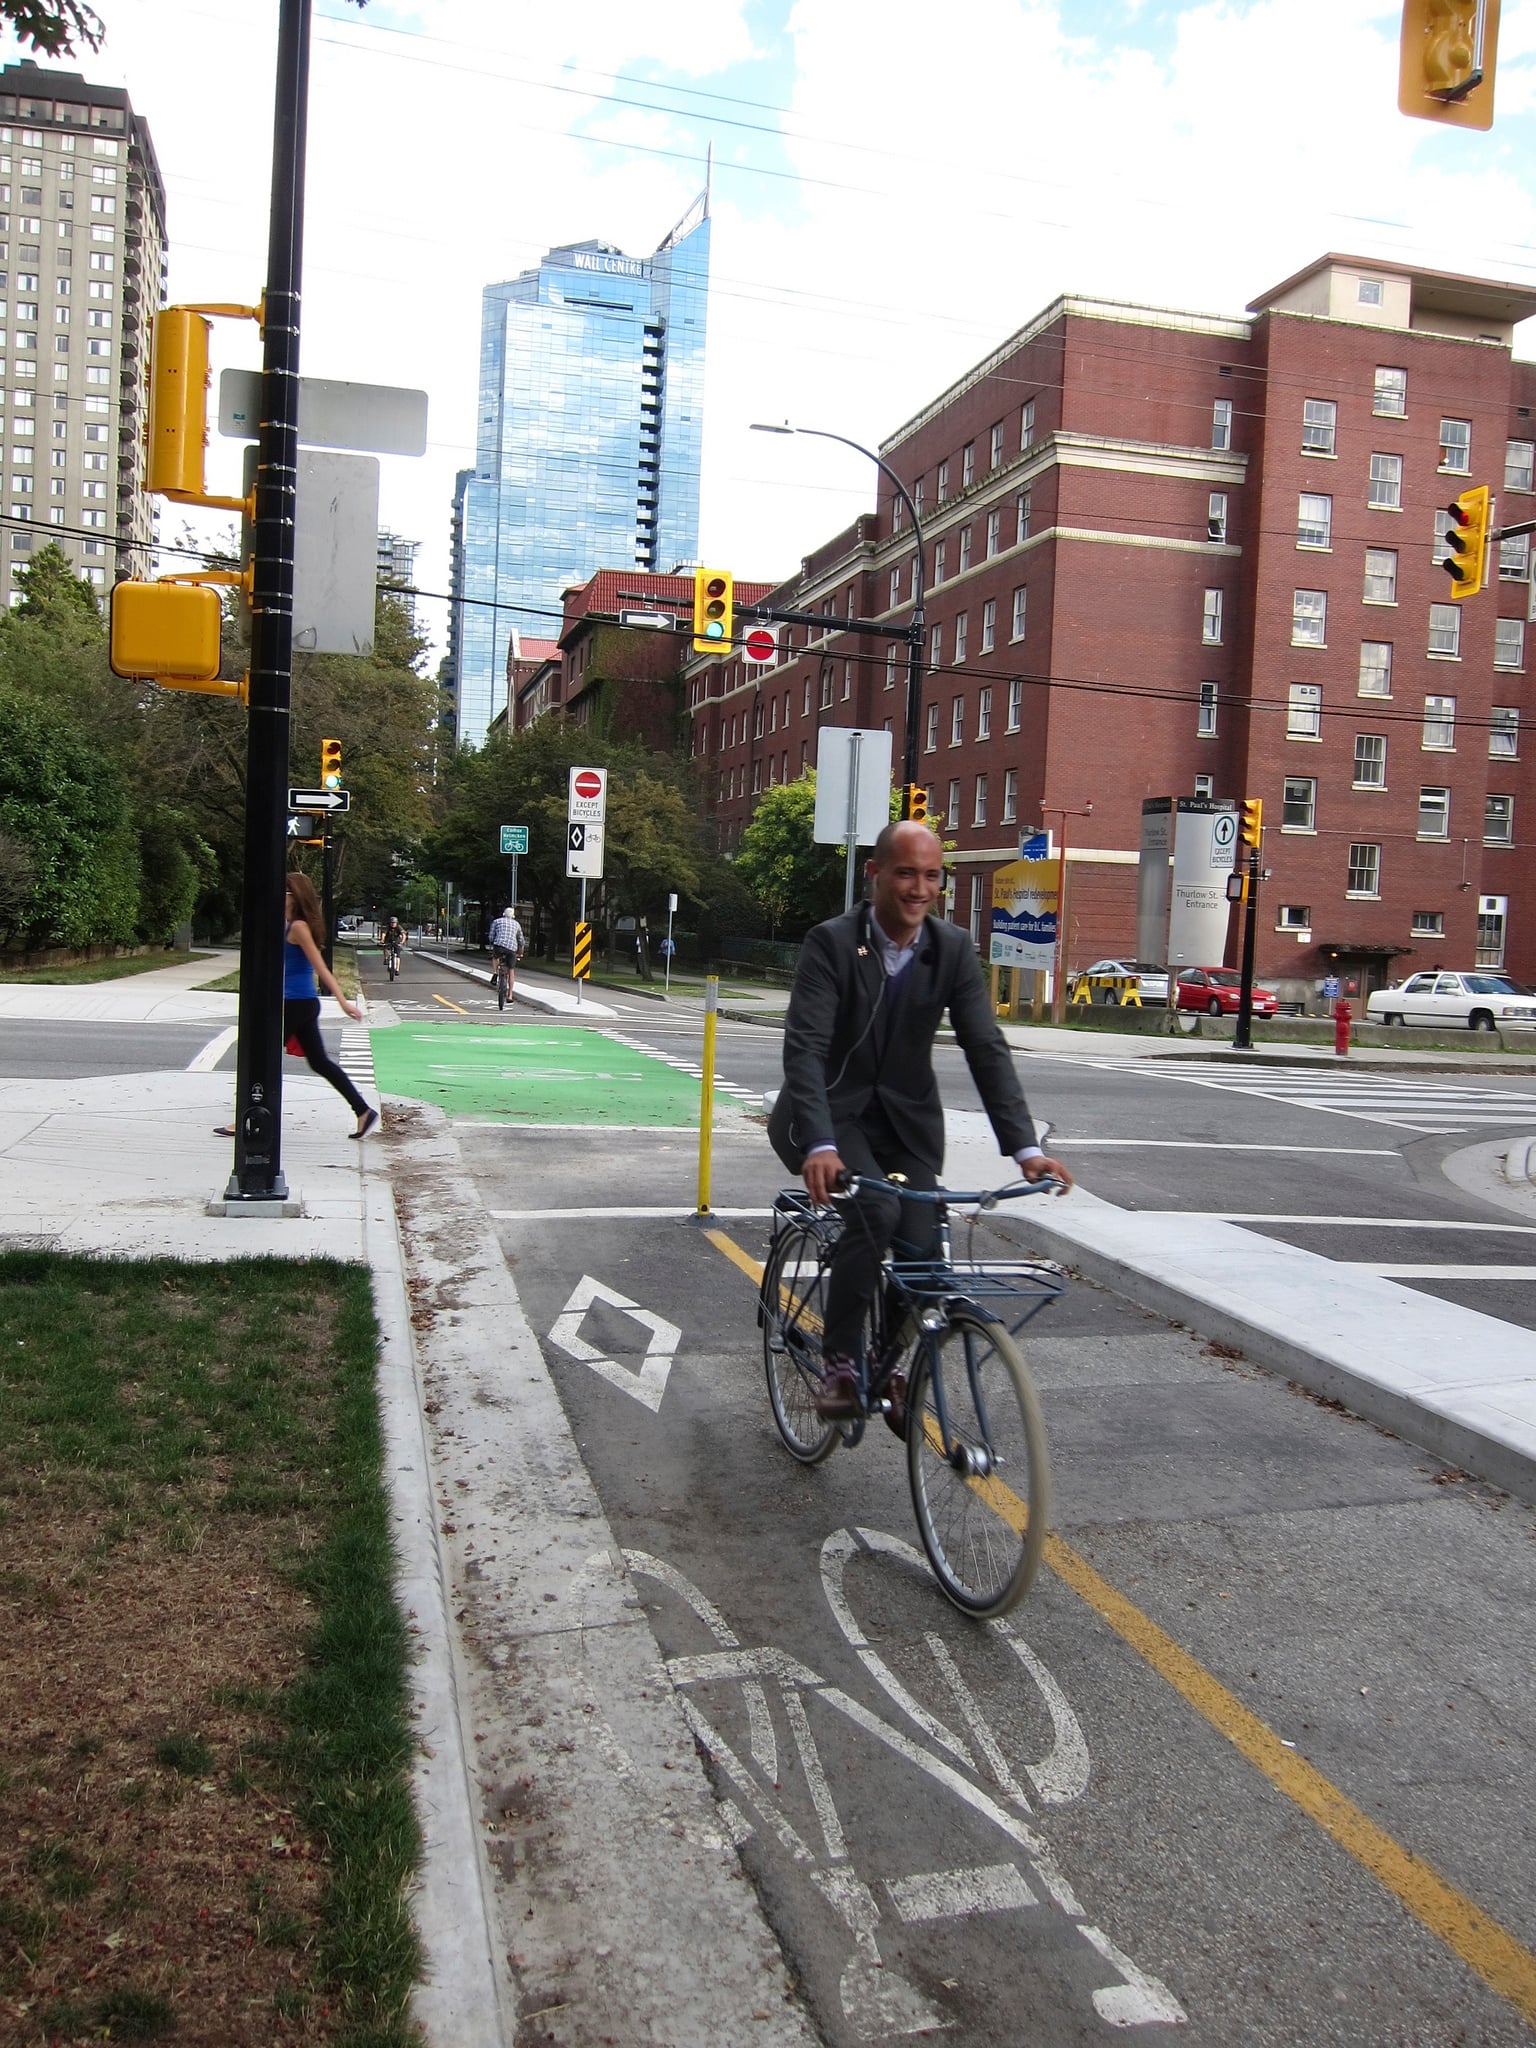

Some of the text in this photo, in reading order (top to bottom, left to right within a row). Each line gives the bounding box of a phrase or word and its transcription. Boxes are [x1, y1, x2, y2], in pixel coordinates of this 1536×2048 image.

[574, 253, 642, 277] WALL CENTRE
[575, 801, 599, 809] EXCEPT
[1190, 801, 1208, 809] Paul's
[1209, 802, 1233, 811] Hospital
[572, 809, 601, 817] BICYCLES
[1176, 889, 1218, 899] Thurlow St.
[1186, 899, 1218, 909] Entrance
